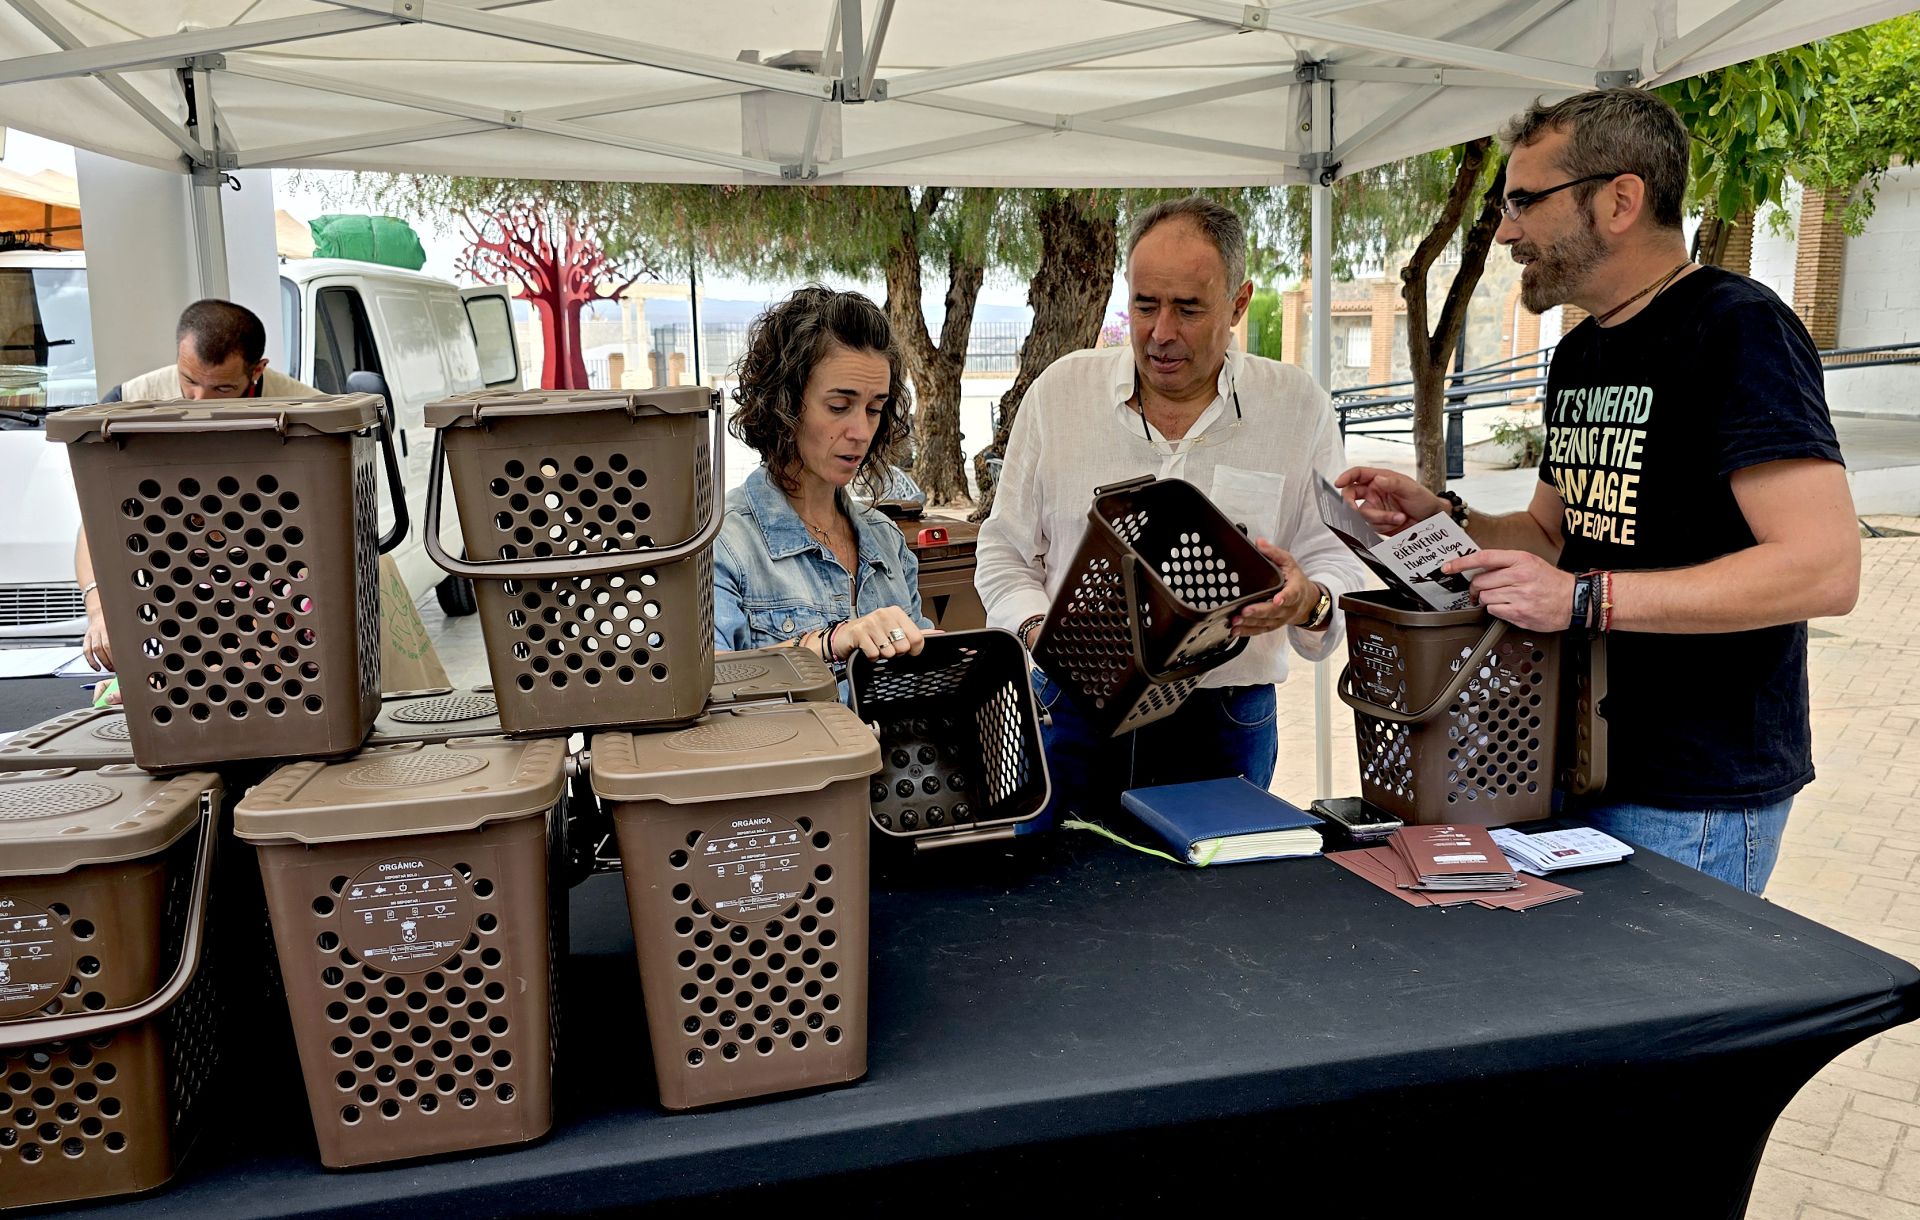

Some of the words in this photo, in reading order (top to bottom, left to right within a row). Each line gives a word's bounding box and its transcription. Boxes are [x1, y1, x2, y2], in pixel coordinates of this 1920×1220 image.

[1586, 386, 1654, 424] WEIRD
[1549, 426, 1599, 465] BEING
[1599, 427, 1647, 470] THE
[1587, 470, 1640, 514] AGE
[1571, 510, 1636, 545] PEOPLE
[1393, 529, 1449, 560] BIENVENIDO
[1437, 541, 1463, 555] Vega
[732, 817, 773, 828] ORGÁNICA
[378, 861, 424, 872] ORGÁNICA
